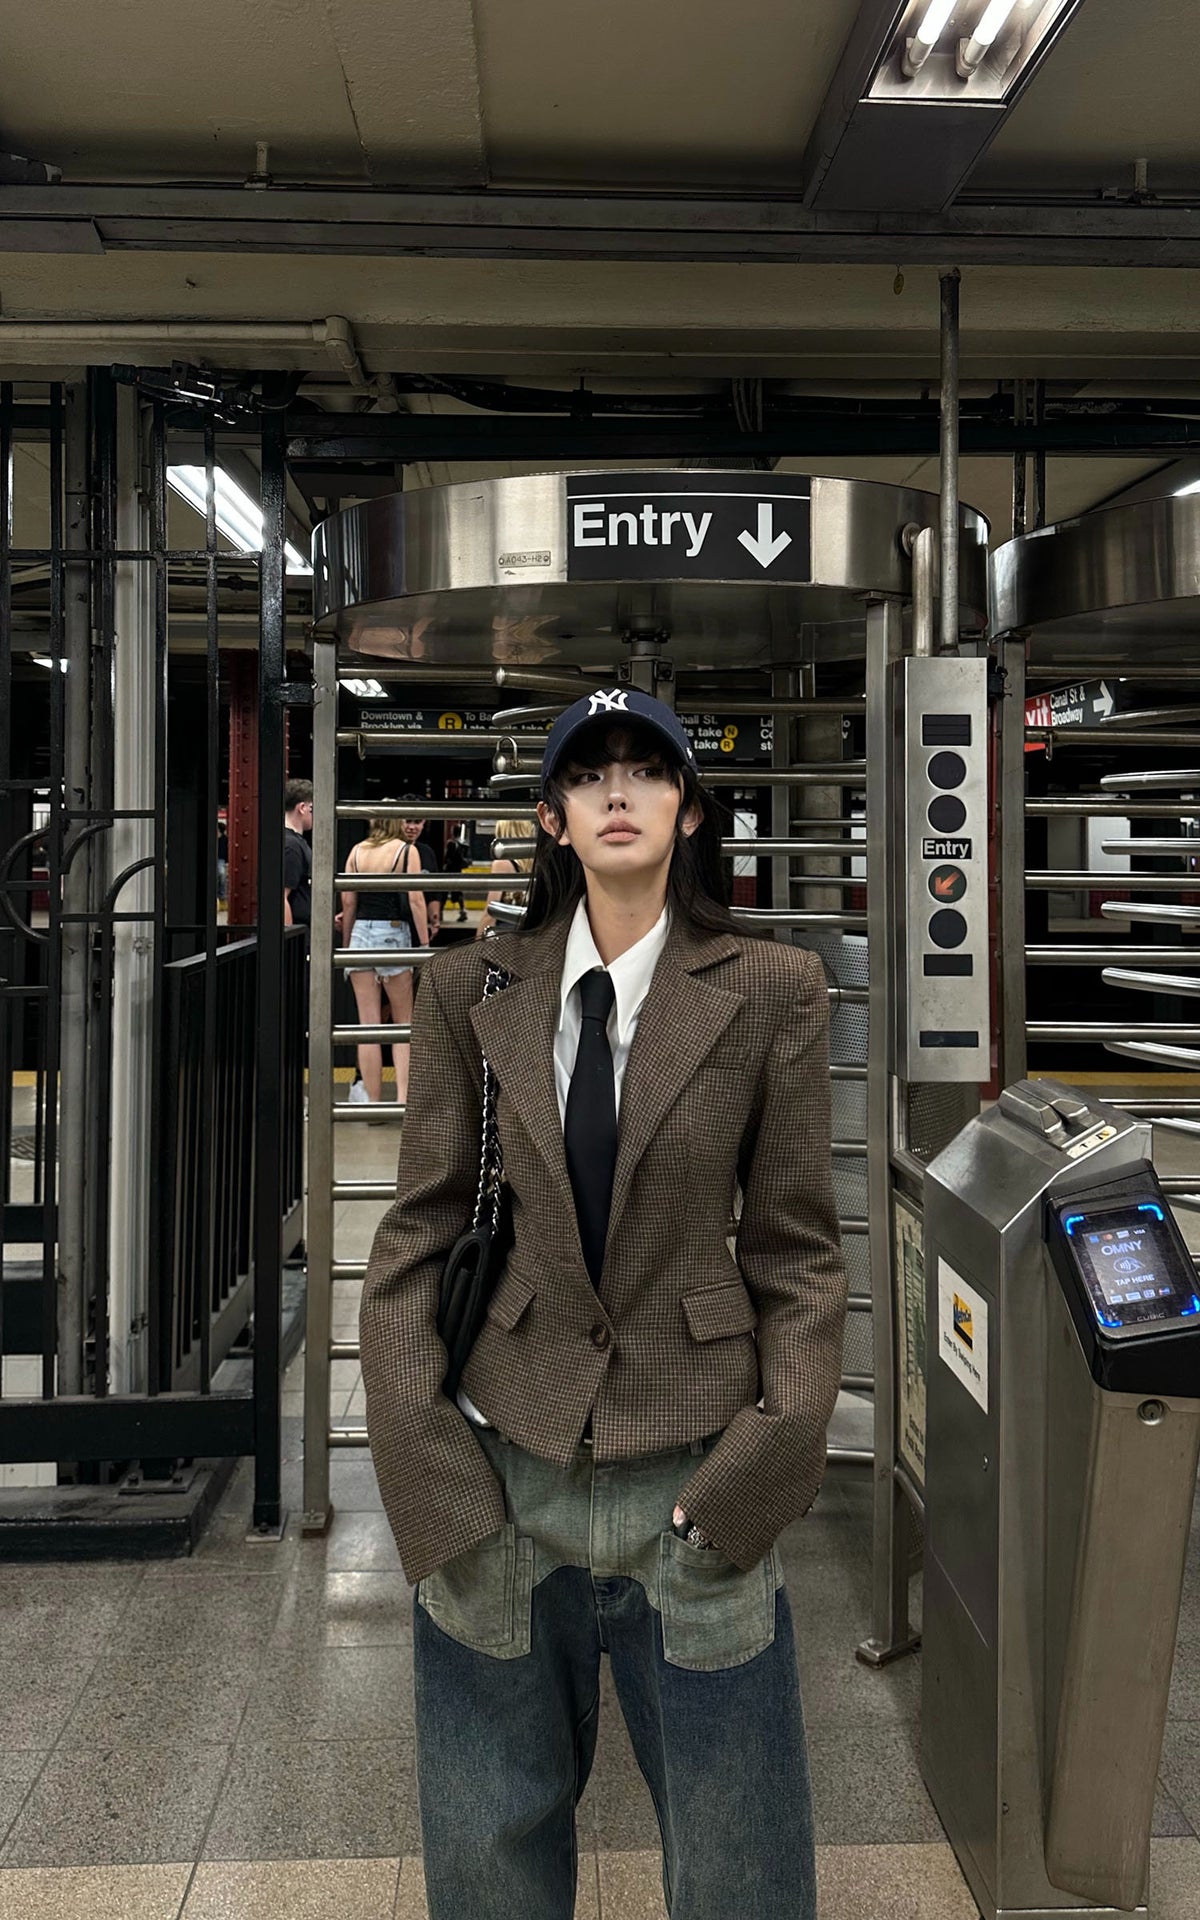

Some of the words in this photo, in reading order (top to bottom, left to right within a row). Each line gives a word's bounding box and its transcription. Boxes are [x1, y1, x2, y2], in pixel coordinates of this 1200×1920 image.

[574, 503, 713, 557] Entry
[588, 688, 629, 716] NY
[1050, 690, 1067, 709] Canal
[1069, 688, 1078, 704] St
[1080, 686, 1085, 702] &
[361, 711, 412, 720] Downtown
[416, 712, 423, 720] &
[464, 712, 476, 721] To
[479, 712, 493, 721] Ba
[677, 714, 700, 724] hall
[703, 714, 718, 725] St.
[1051, 707, 1083, 726] Broadway
[698, 727, 722, 737] take
[694, 739, 719, 749] take
[924, 840, 969, 859] Entry
[1101, 1240, 1142, 1256] OMNY
[1115, 1278, 1131, 1286] TAP
[1131, 1273, 1155, 1284] HERE
